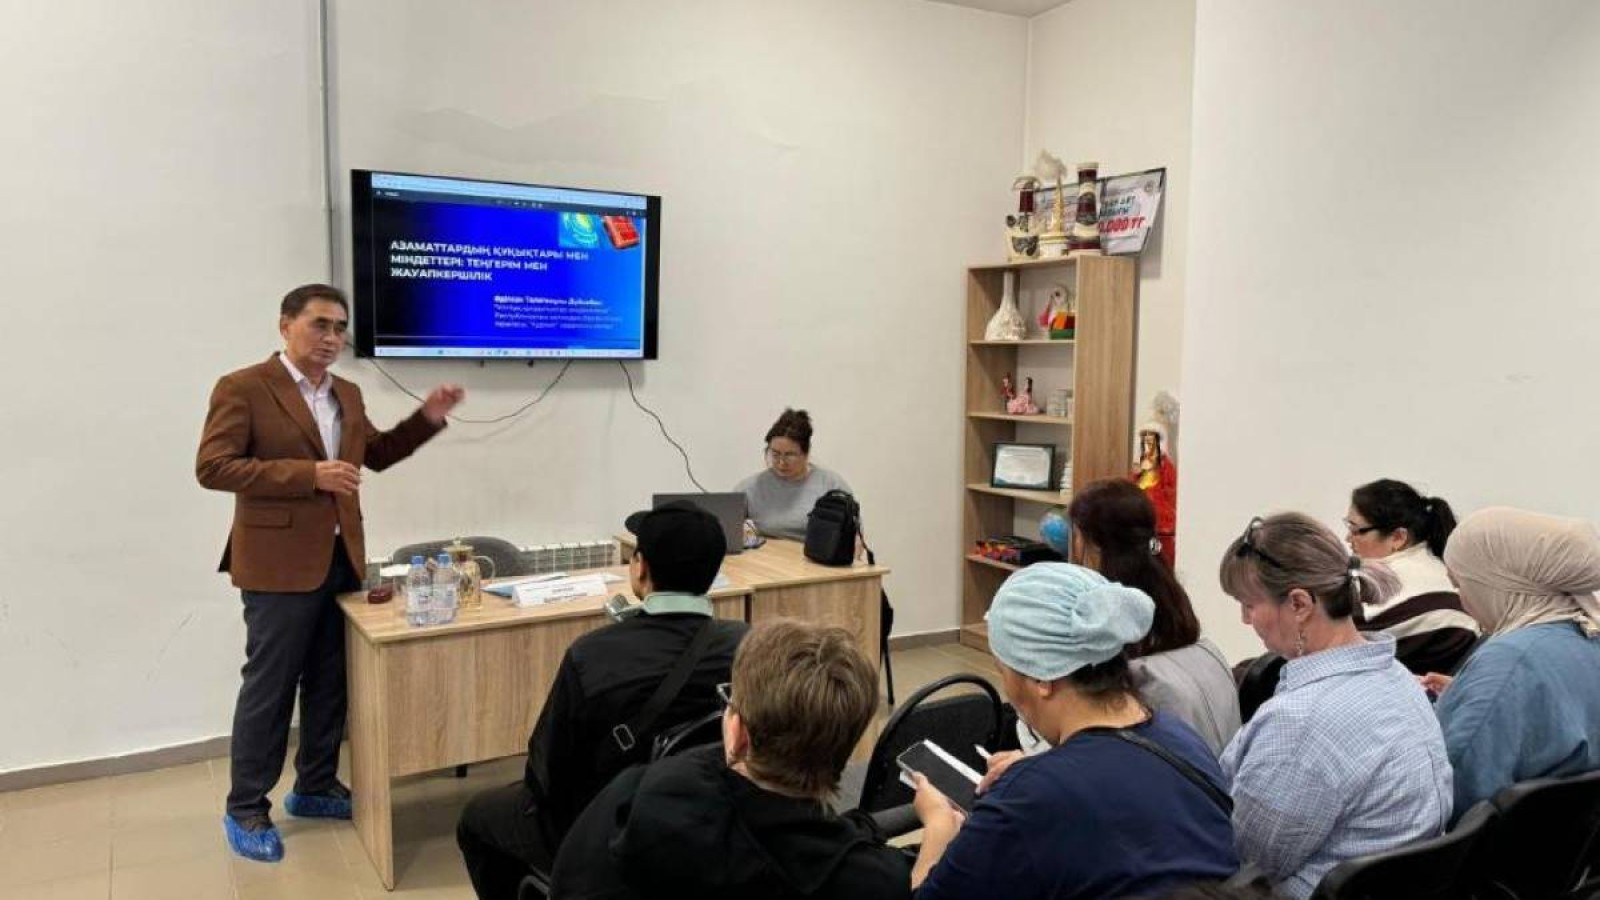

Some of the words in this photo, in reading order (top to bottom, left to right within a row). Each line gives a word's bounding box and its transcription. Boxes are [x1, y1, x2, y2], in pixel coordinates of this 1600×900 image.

[391, 241, 489, 256] АЗАМАТТАРДЫҢ
[467, 257, 521, 270] ТЕҢГЕРІМ
[524, 261, 548, 271] МЕН
[391, 268, 493, 281] ЖАУАПКЕРШІЛІК
